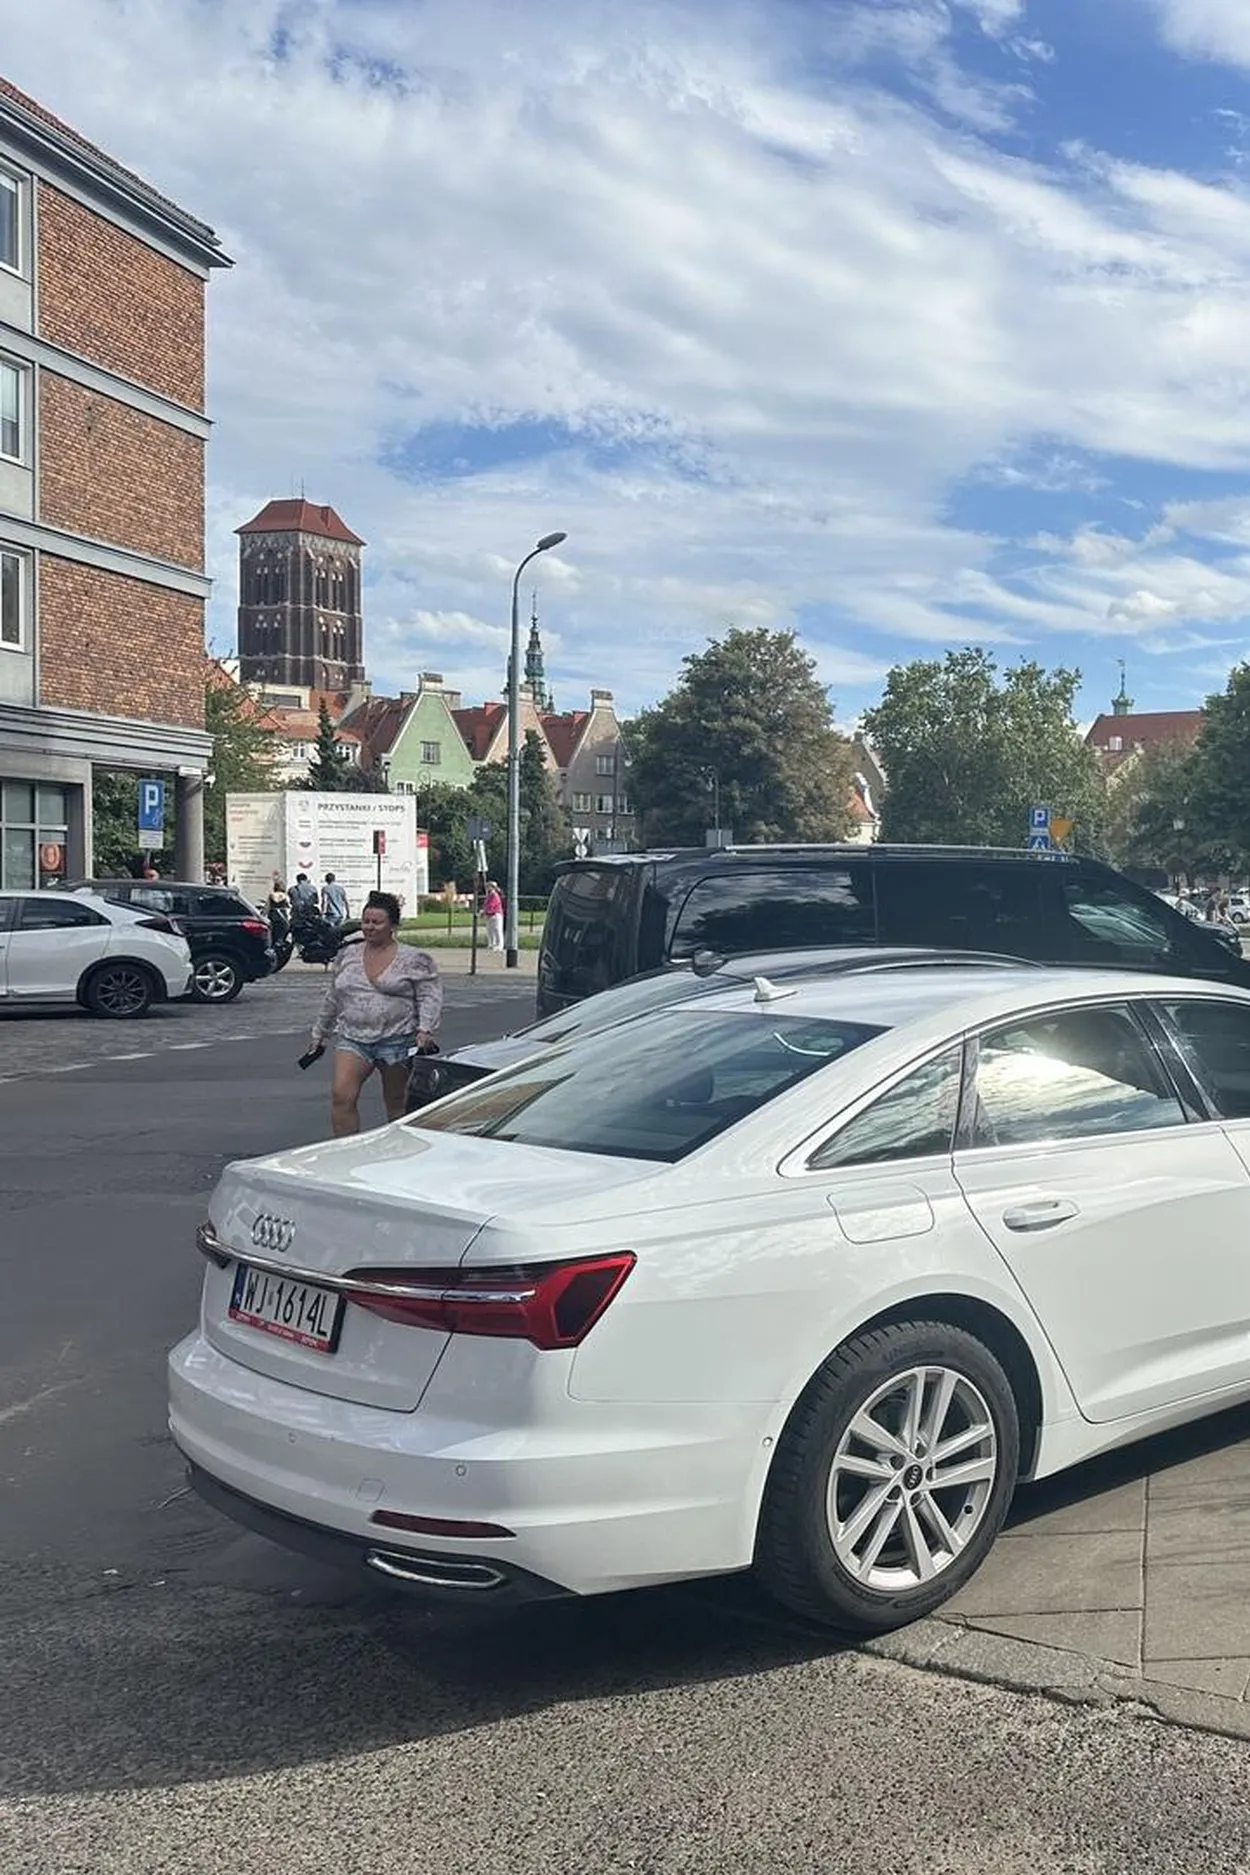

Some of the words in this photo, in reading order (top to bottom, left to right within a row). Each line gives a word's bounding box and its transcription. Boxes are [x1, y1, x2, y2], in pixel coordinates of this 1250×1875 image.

[145, 784, 159, 815] P
[317, 803, 371, 812] PRZYSTANKI
[378, 803, 406, 813] STOPS
[1034, 810, 1046, 826] P
[274, 1281, 328, 1337] 1614L
